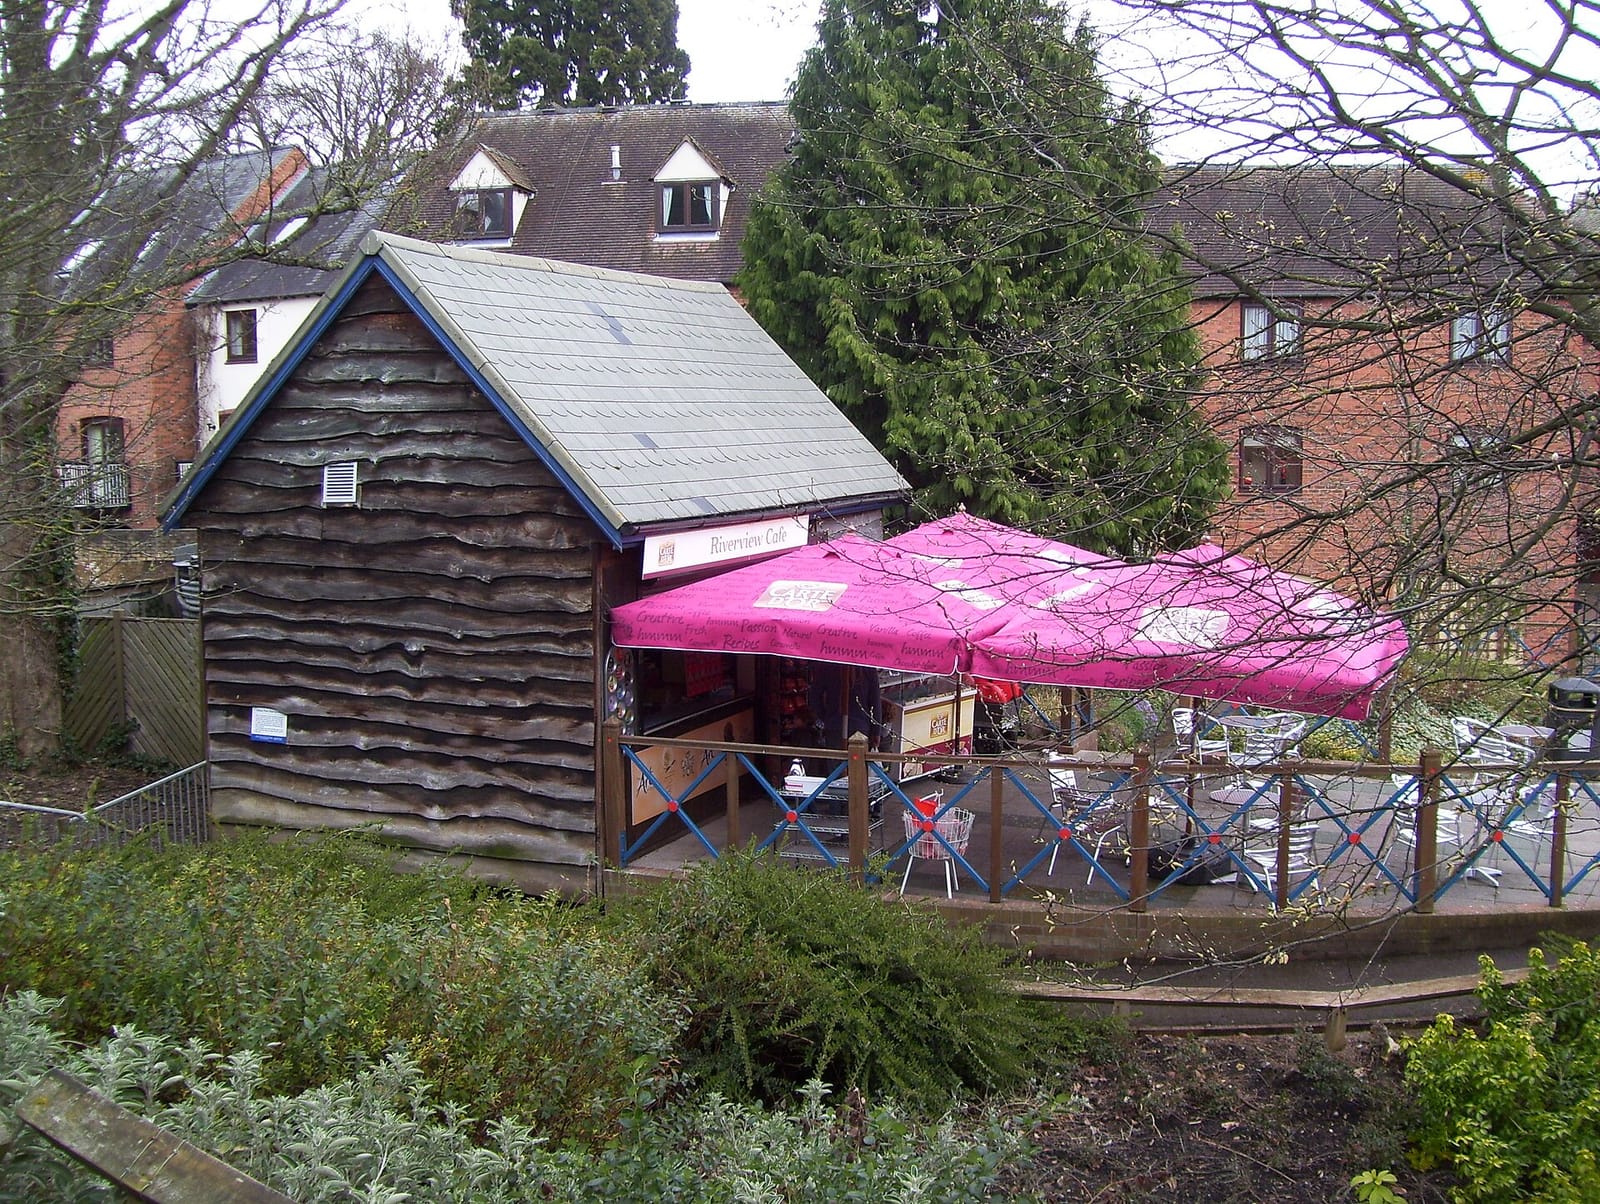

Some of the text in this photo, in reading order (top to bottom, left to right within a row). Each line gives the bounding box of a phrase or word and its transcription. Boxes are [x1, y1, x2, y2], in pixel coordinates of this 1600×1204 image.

[711, 531, 762, 555] Riverview
[636, 610, 684, 625] Creative
[740, 619, 777, 633] Passion
[817, 624, 858, 640] Creative
[869, 624, 899, 635] Vanilla
[723, 634, 760, 650] Recipes
